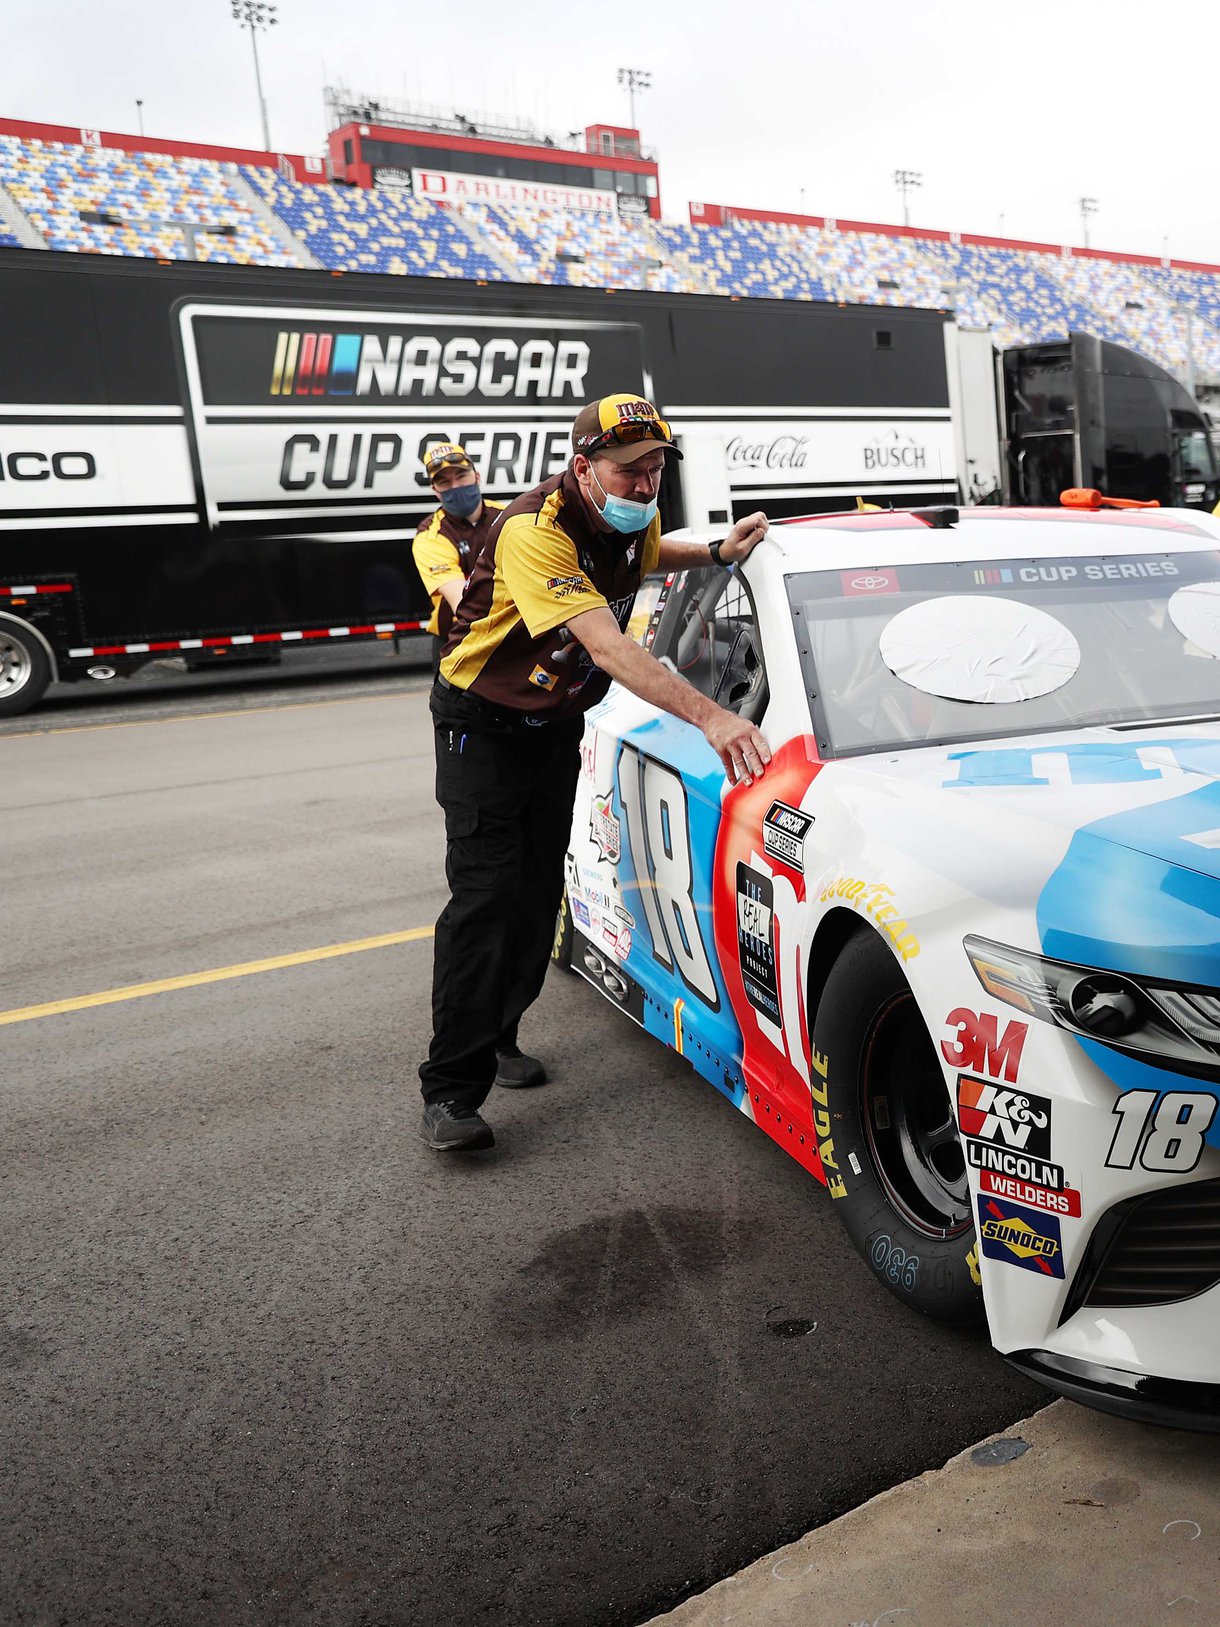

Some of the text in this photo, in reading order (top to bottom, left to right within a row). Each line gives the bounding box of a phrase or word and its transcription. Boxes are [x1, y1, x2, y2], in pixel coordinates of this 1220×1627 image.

[419, 172, 612, 210] DARLINGTON
[356, 335, 591, 398] NASCAR
[280, 431, 571, 492] CUP SERIE
[864, 447, 926, 469] BUSCH
[1019, 561, 1179, 583] CUP SERIES
[779, 811, 806, 834] NASCAR
[779, 835, 798, 857] SERIES
[617, 739, 722, 1011] 18
[745, 879, 762, 903] THE
[739, 925, 773, 966] HEROES
[746, 955, 769, 979] PROJECT
[940, 1007, 1029, 1084] 3M
[811, 1043, 848, 1200] EAGLE
[975, 1085, 1048, 1150] K&N
[1104, 1087, 1219, 1174] 18
[970, 1145, 1060, 1188] LINCOLN
[990, 1174, 1070, 1213] WELDERS
[984, 1222, 1057, 1256] SUNOCO
